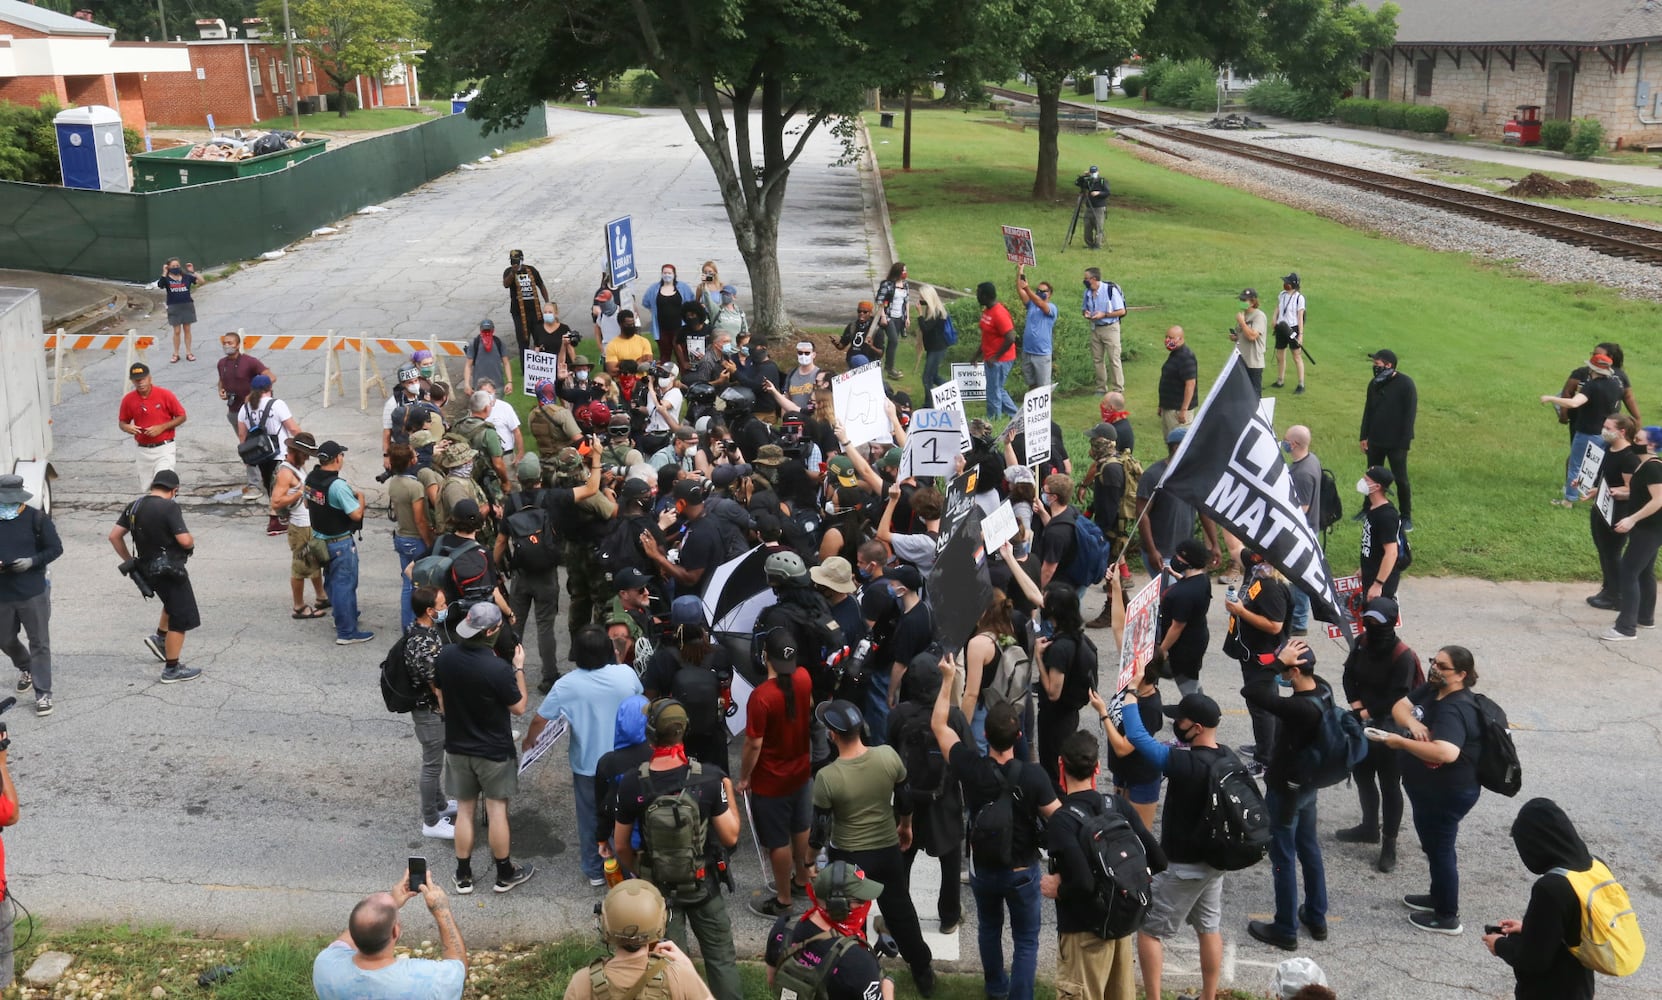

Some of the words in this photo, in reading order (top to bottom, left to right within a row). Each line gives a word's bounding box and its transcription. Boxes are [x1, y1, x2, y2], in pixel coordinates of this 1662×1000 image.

[613, 254, 632, 270] LIBRARY
[526, 353, 554, 365] FIGHT
[527, 364, 553, 373] AGAINST
[935, 386, 958, 405] NAZIS
[1027, 394, 1049, 412] STOP
[917, 411, 952, 428] USA
[1027, 411, 1049, 426] FASCISM
[922, 437, 948, 464] 1
[937, 532, 950, 550] No
[1205, 471, 1334, 603] MATTE
[1129, 580, 1158, 621] REMOVE
[1330, 622, 1359, 637] TE
[1119, 663, 1134, 687] THE
